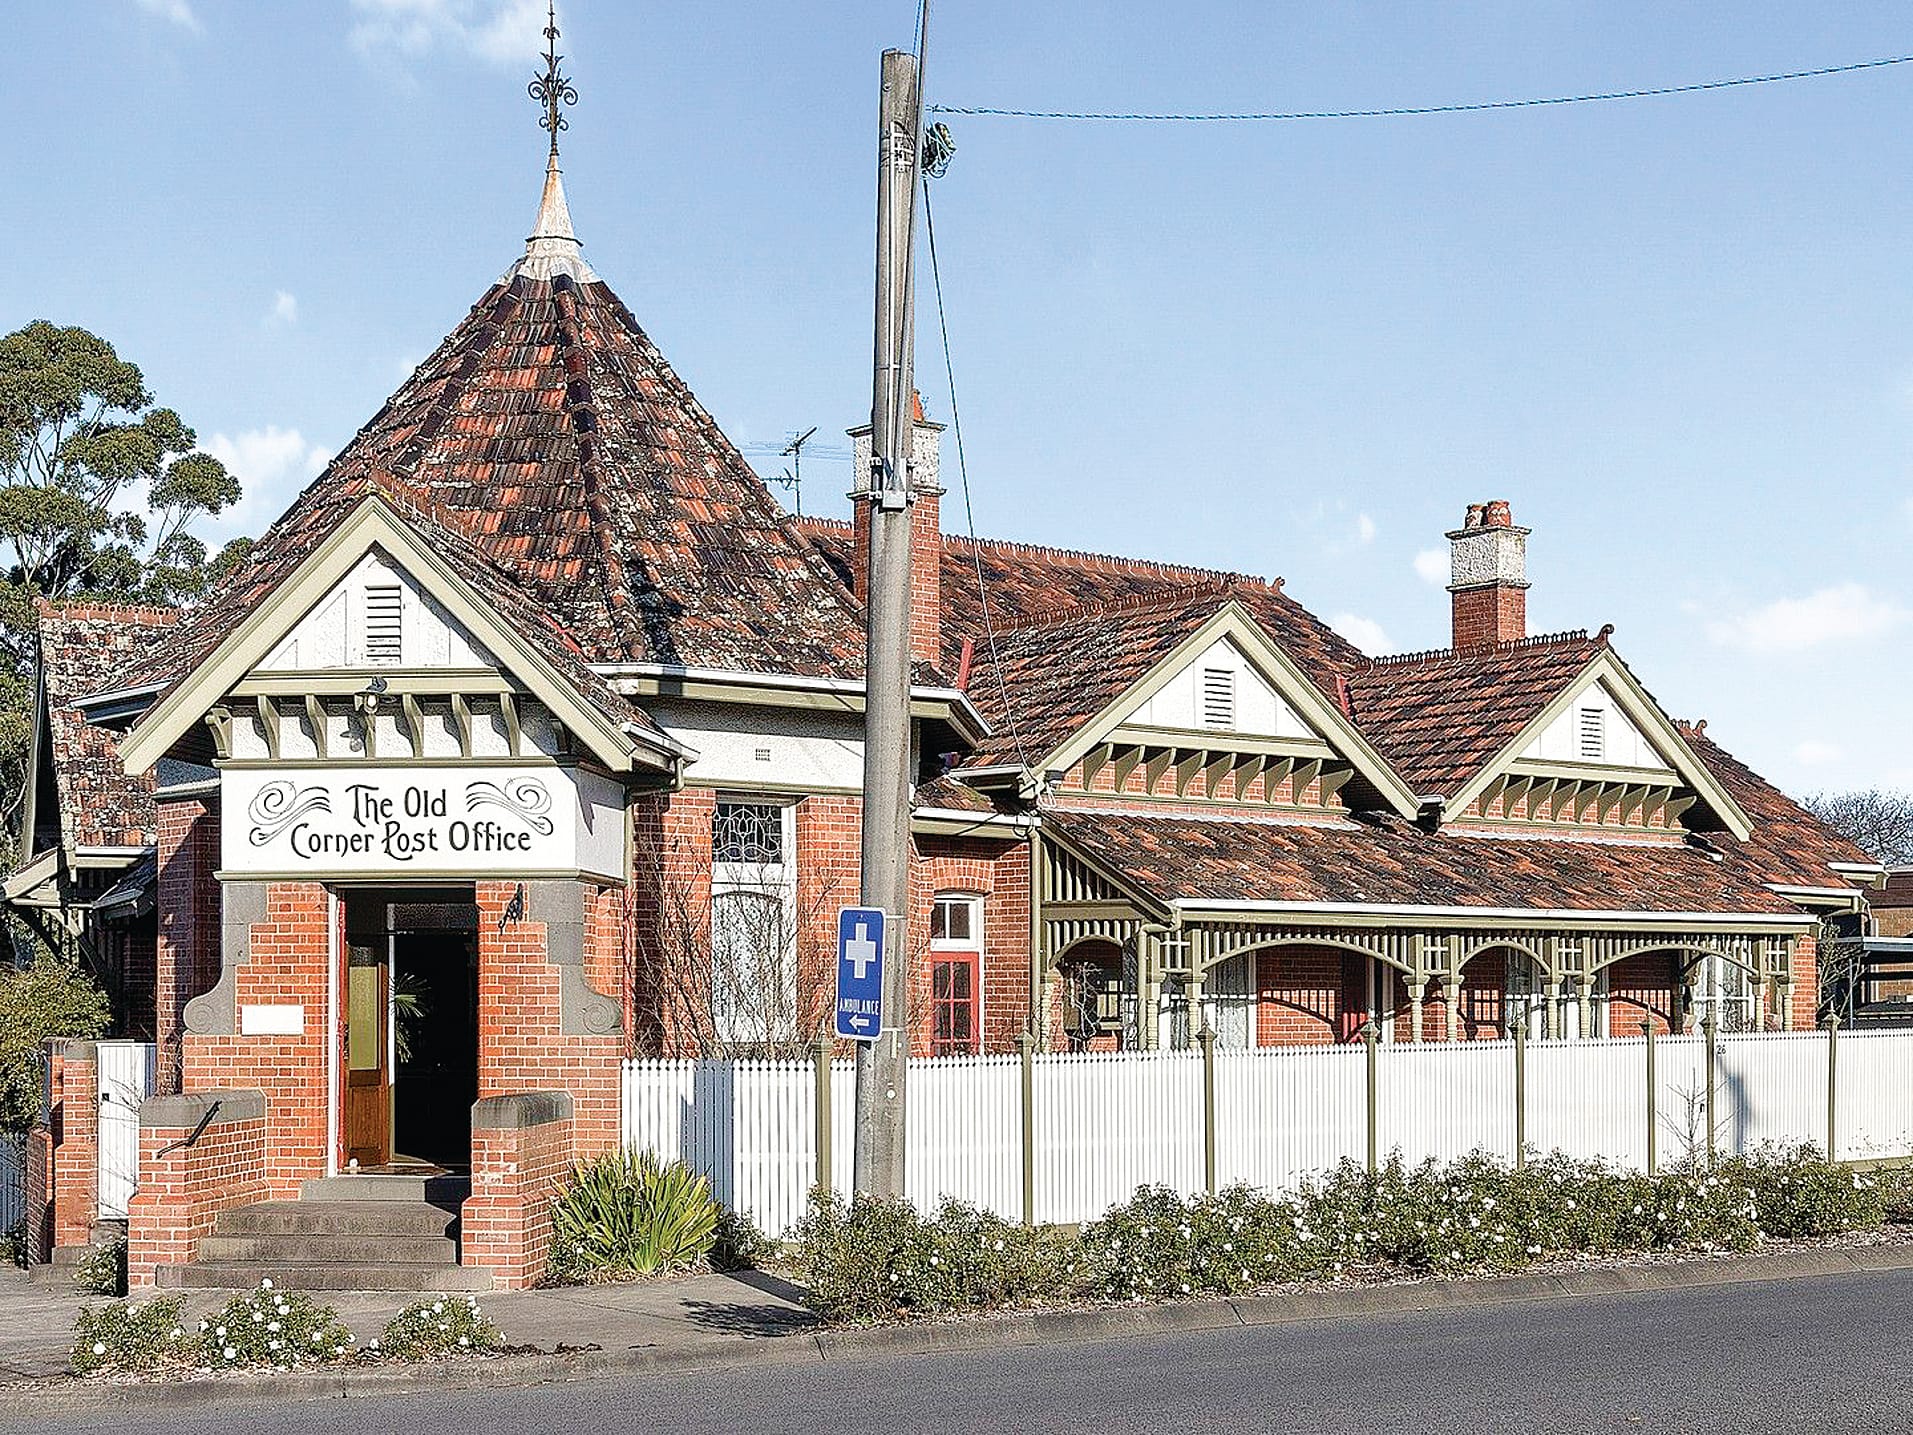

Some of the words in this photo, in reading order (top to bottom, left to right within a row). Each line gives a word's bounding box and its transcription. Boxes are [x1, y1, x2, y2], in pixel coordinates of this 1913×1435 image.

[345, 785, 394, 827] The
[404, 787, 448, 817] Old
[291, 823, 375, 859] Corner
[381, 821, 438, 861] Post
[448, 821, 532, 852] Office
[839, 998, 879, 1016] AMBULANCE
